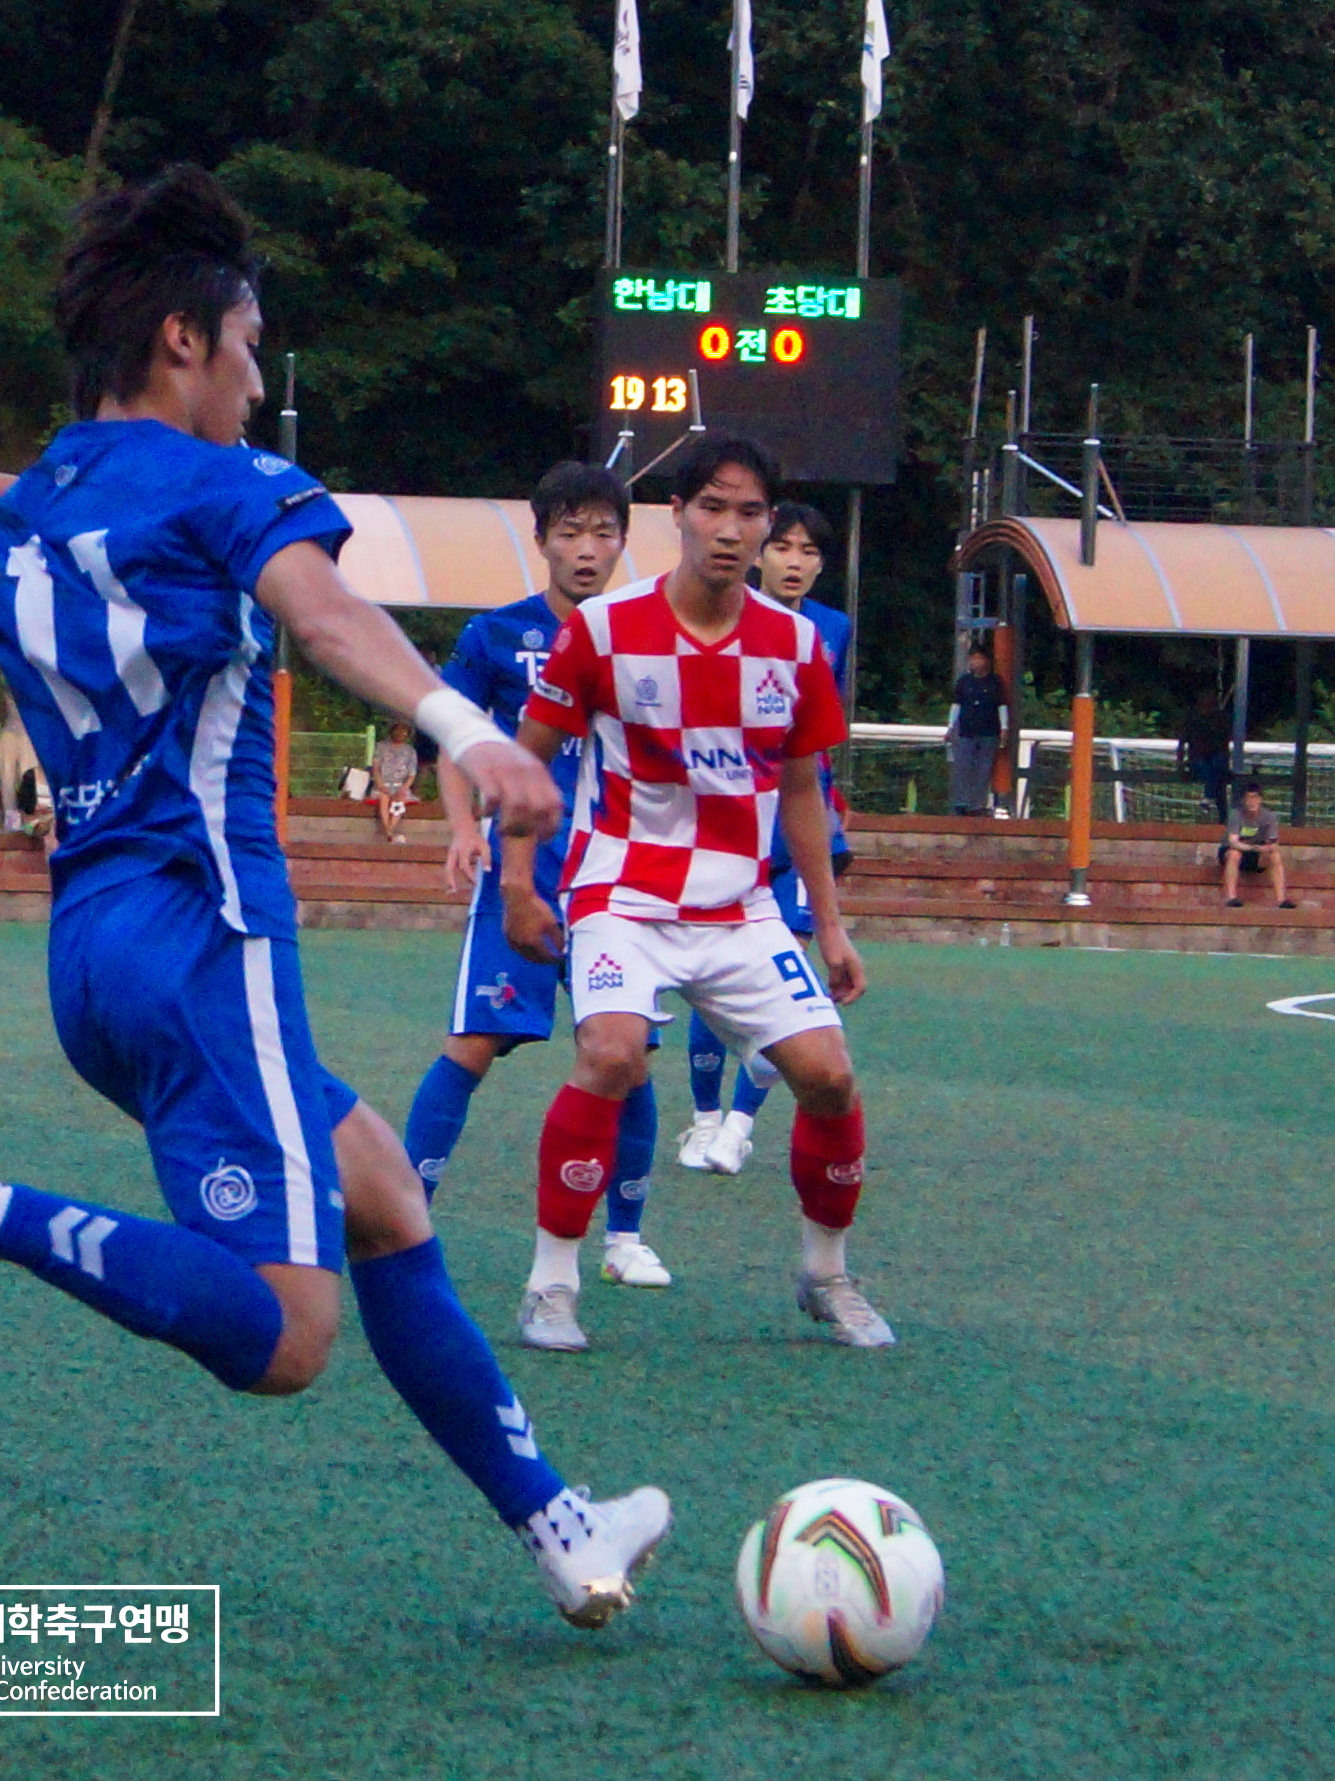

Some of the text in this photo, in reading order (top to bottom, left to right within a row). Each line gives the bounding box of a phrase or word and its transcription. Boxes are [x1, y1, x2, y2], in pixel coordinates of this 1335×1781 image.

[613, 277, 861, 319] 한남대 초당대
[700, 325, 803, 363] 0 전 0
[610, 375, 687, 412] 19 13
